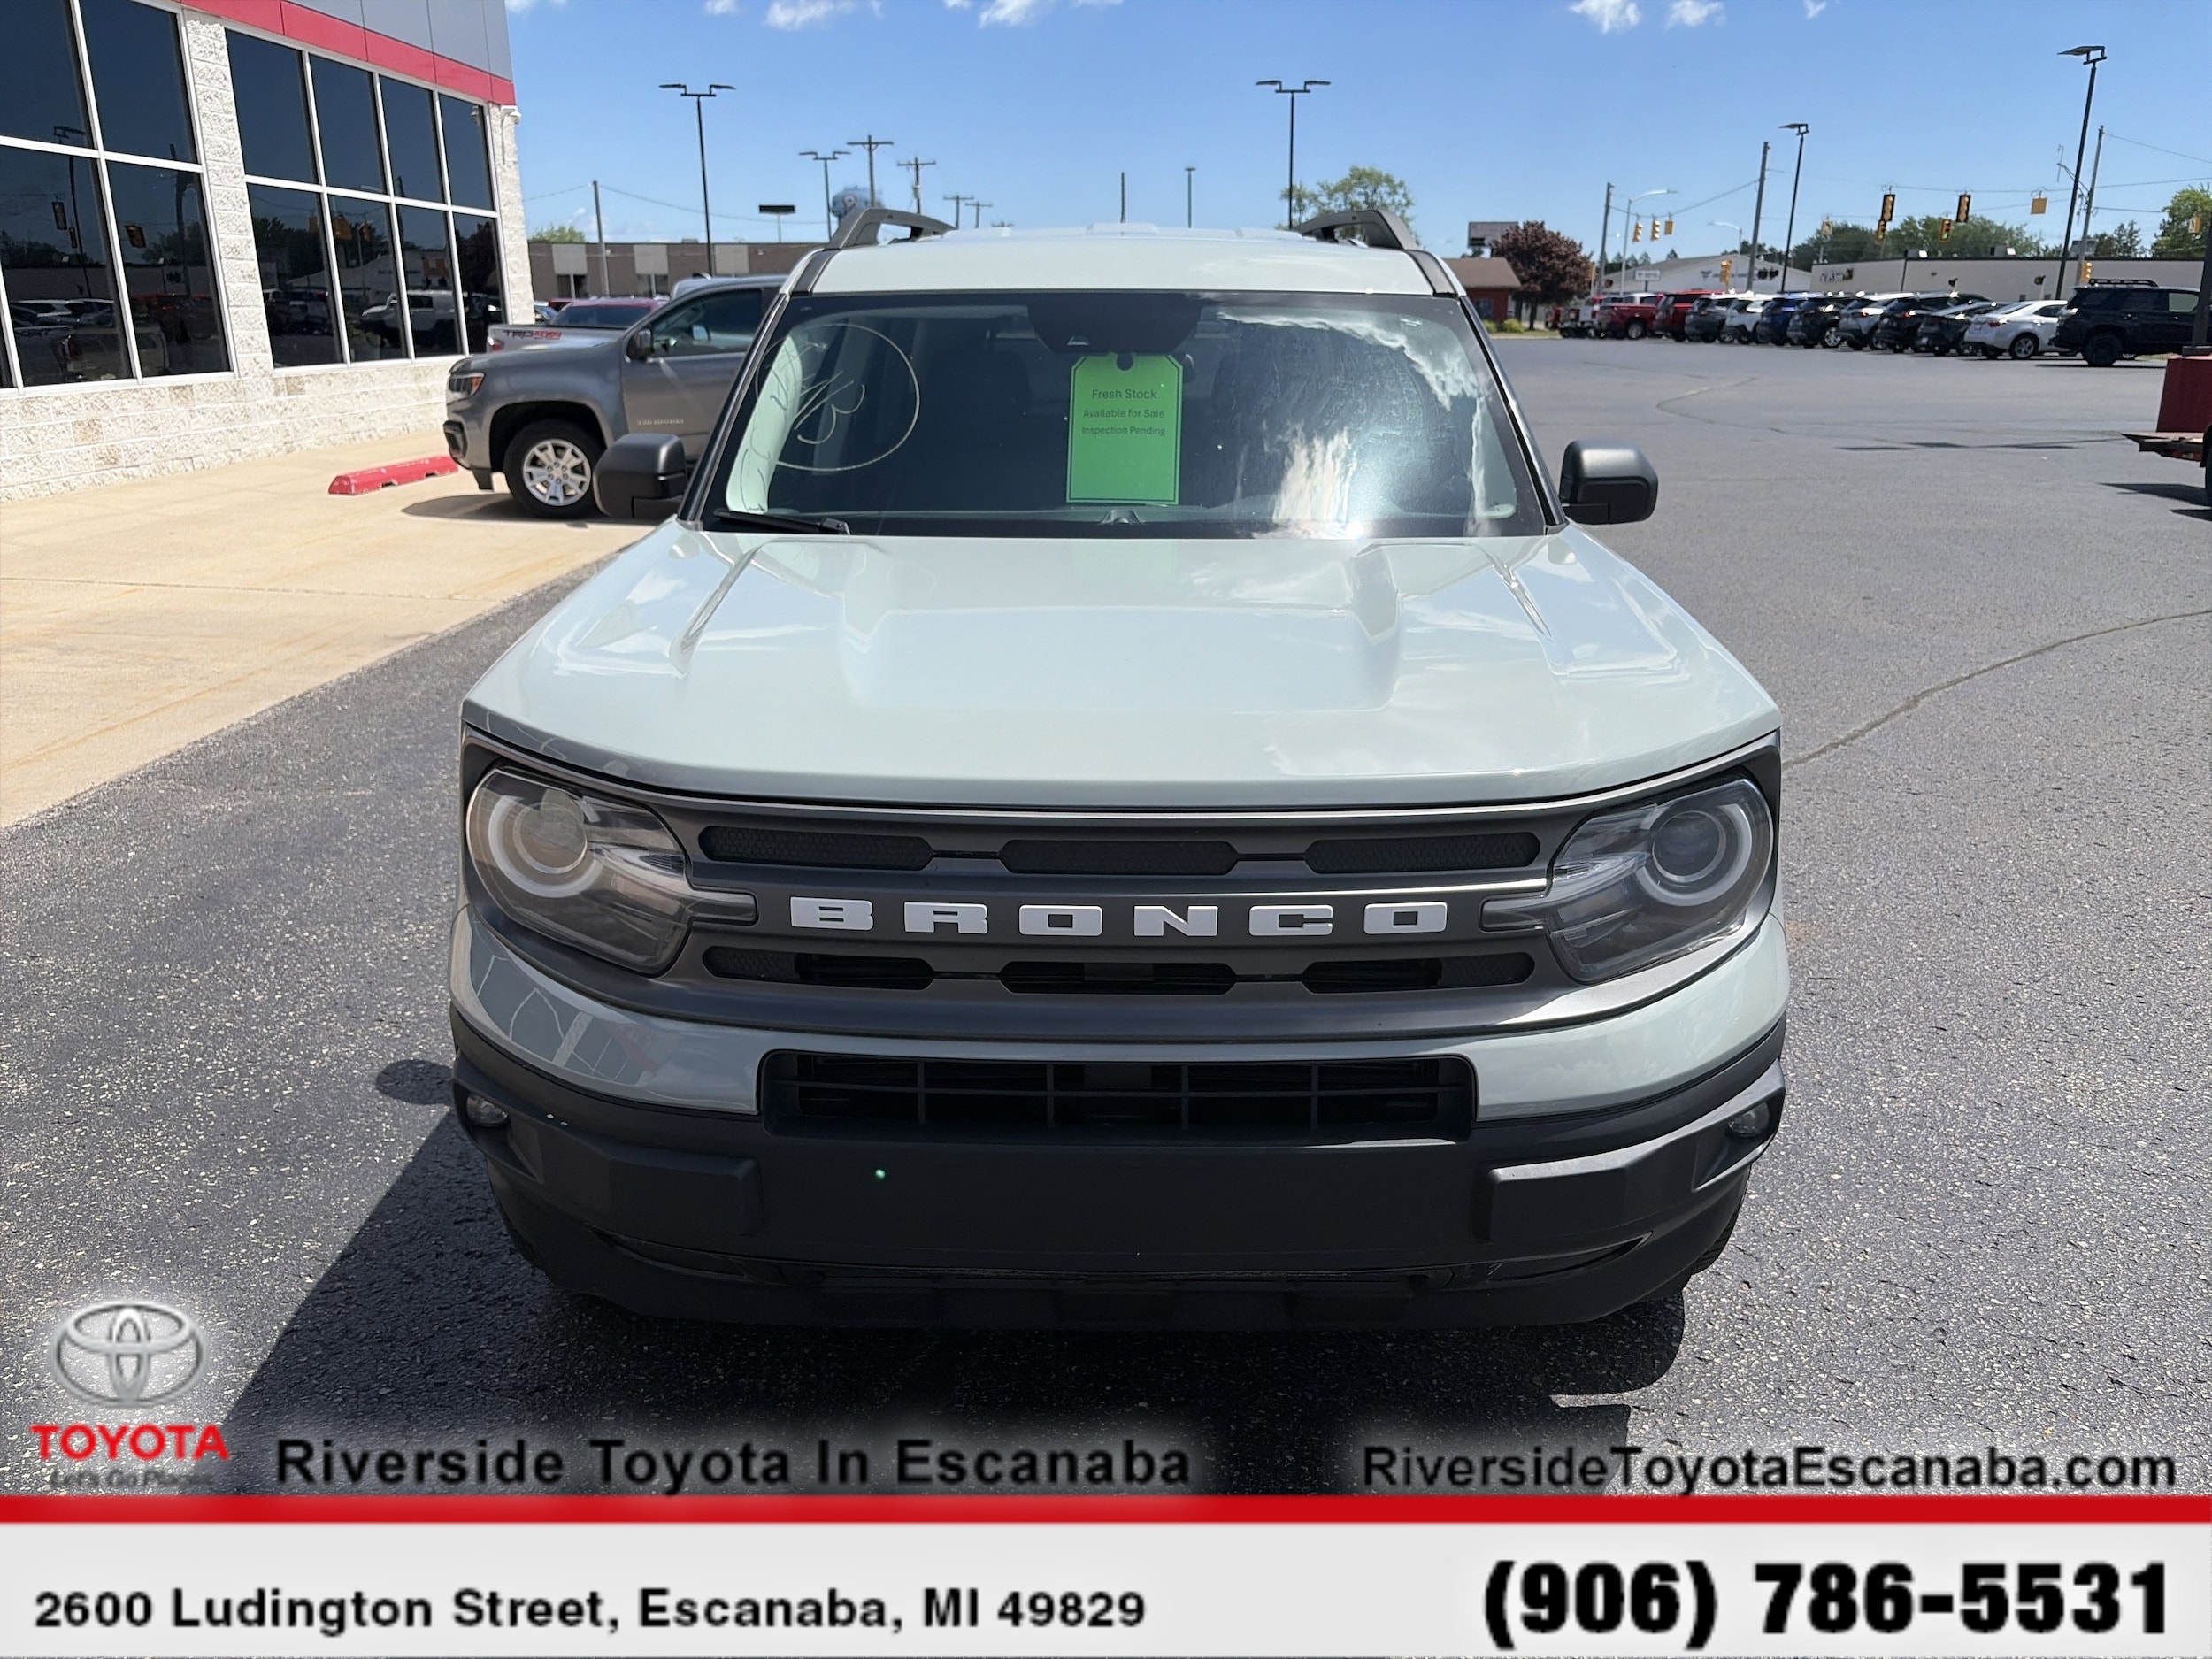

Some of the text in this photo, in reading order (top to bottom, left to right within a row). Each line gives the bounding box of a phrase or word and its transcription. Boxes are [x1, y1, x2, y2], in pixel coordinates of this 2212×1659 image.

[1091, 388, 1157, 400] Fresh Stock
[1082, 409, 1165, 419] Available for Sale
[1081, 426, 1166, 437] Inspection Pending
[789, 896, 1448, 937] BRONCO
